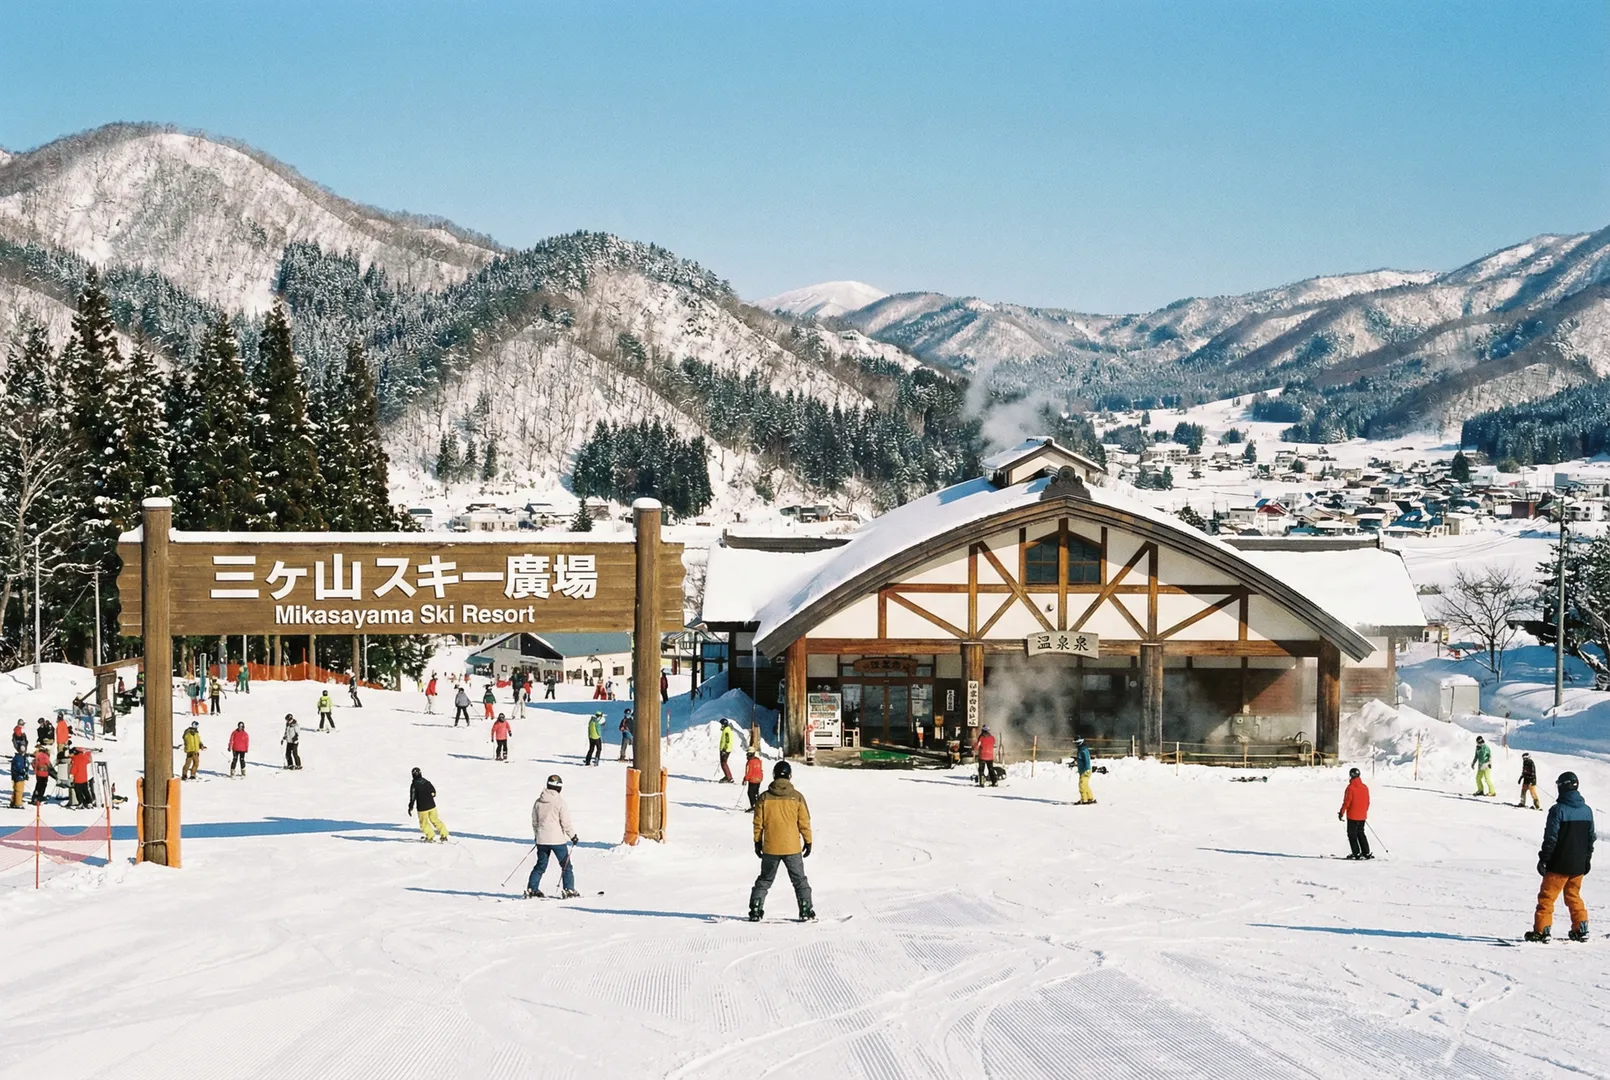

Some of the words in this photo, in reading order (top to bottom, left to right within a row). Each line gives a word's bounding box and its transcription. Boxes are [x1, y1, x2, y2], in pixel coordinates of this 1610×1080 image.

[275, 604, 414, 629] Mikasayama
[420, 604, 455, 624] Ski
[462, 604, 536, 624] Resort
[1037, 635, 1089, 651] 温泉泉
